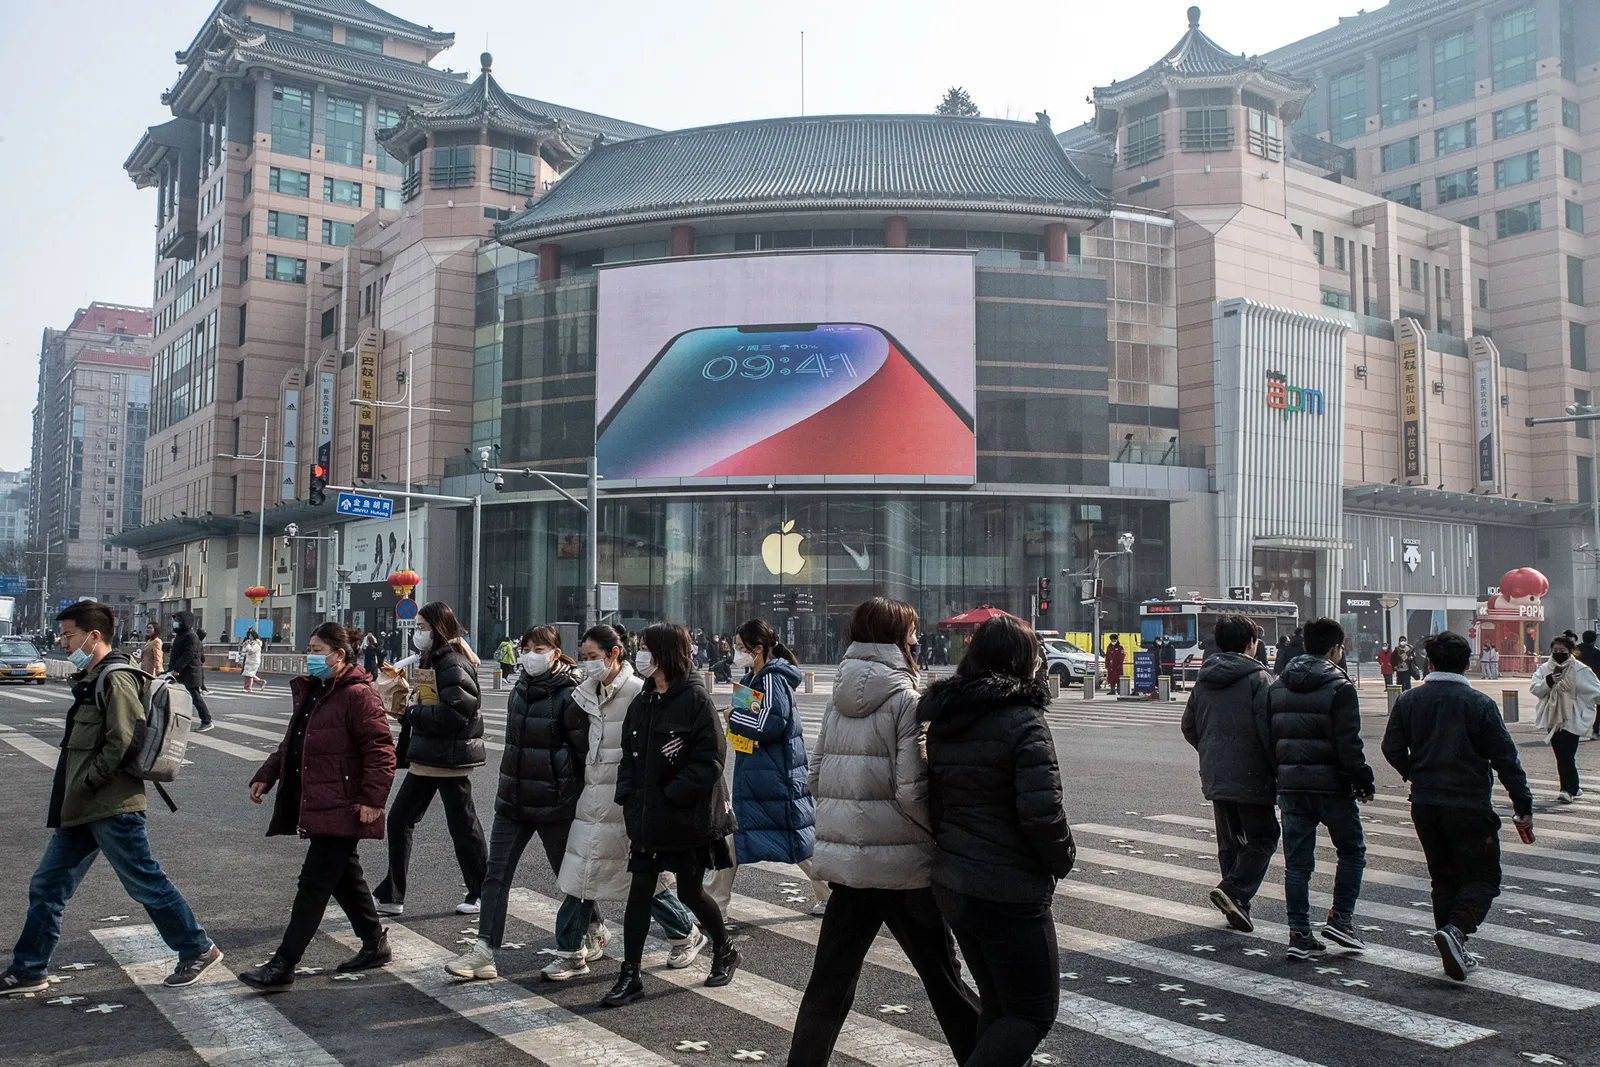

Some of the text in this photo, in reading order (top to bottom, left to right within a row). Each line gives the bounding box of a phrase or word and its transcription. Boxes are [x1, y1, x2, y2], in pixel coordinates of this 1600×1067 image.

[702, 353, 858, 381] 09:41
[1267, 382, 1323, 420] apm
[360, 430, 371, 473] 就在6楼
[1407, 427, 1417, 472] 就在6楼
[352, 498, 390, 511] 金鱼胡同
[371, 589, 382, 601] dyson
[1351, 599, 1371, 607] DESCENTE
